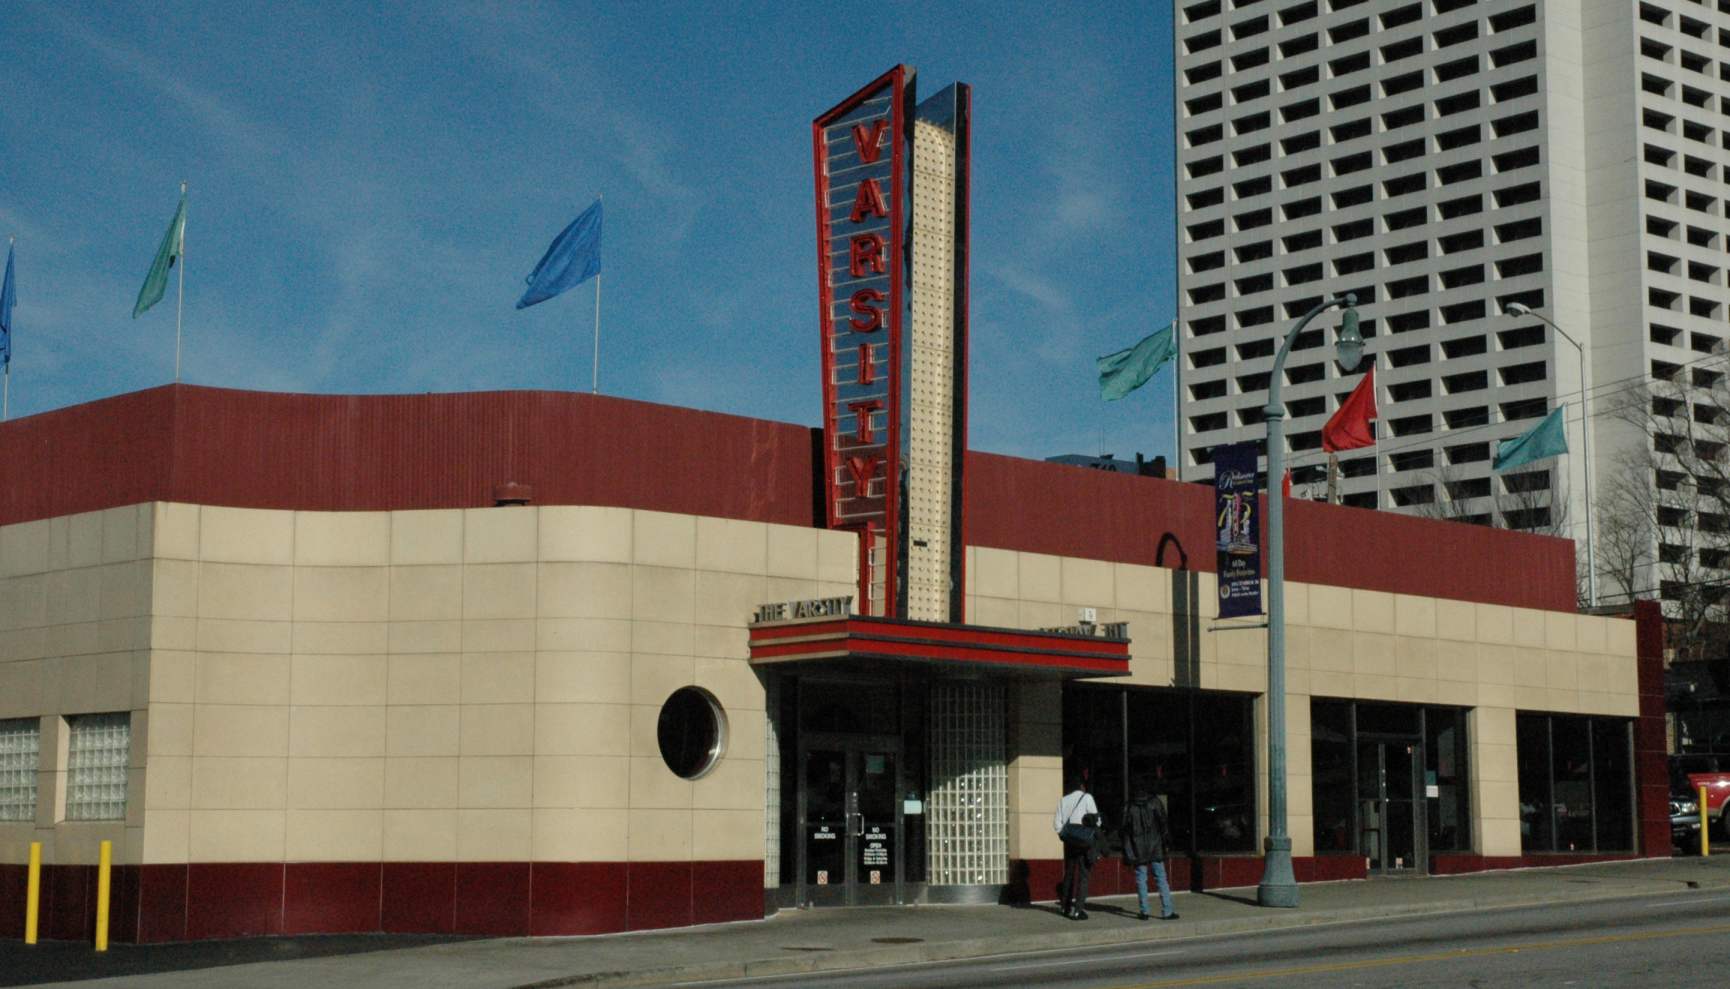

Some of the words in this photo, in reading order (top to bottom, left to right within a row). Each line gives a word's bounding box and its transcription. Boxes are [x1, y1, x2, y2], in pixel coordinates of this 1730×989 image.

[848, 118, 888, 498] VARSITY
[753, 602, 787, 623] THE
[788, 595, 854, 618] VARSITY
